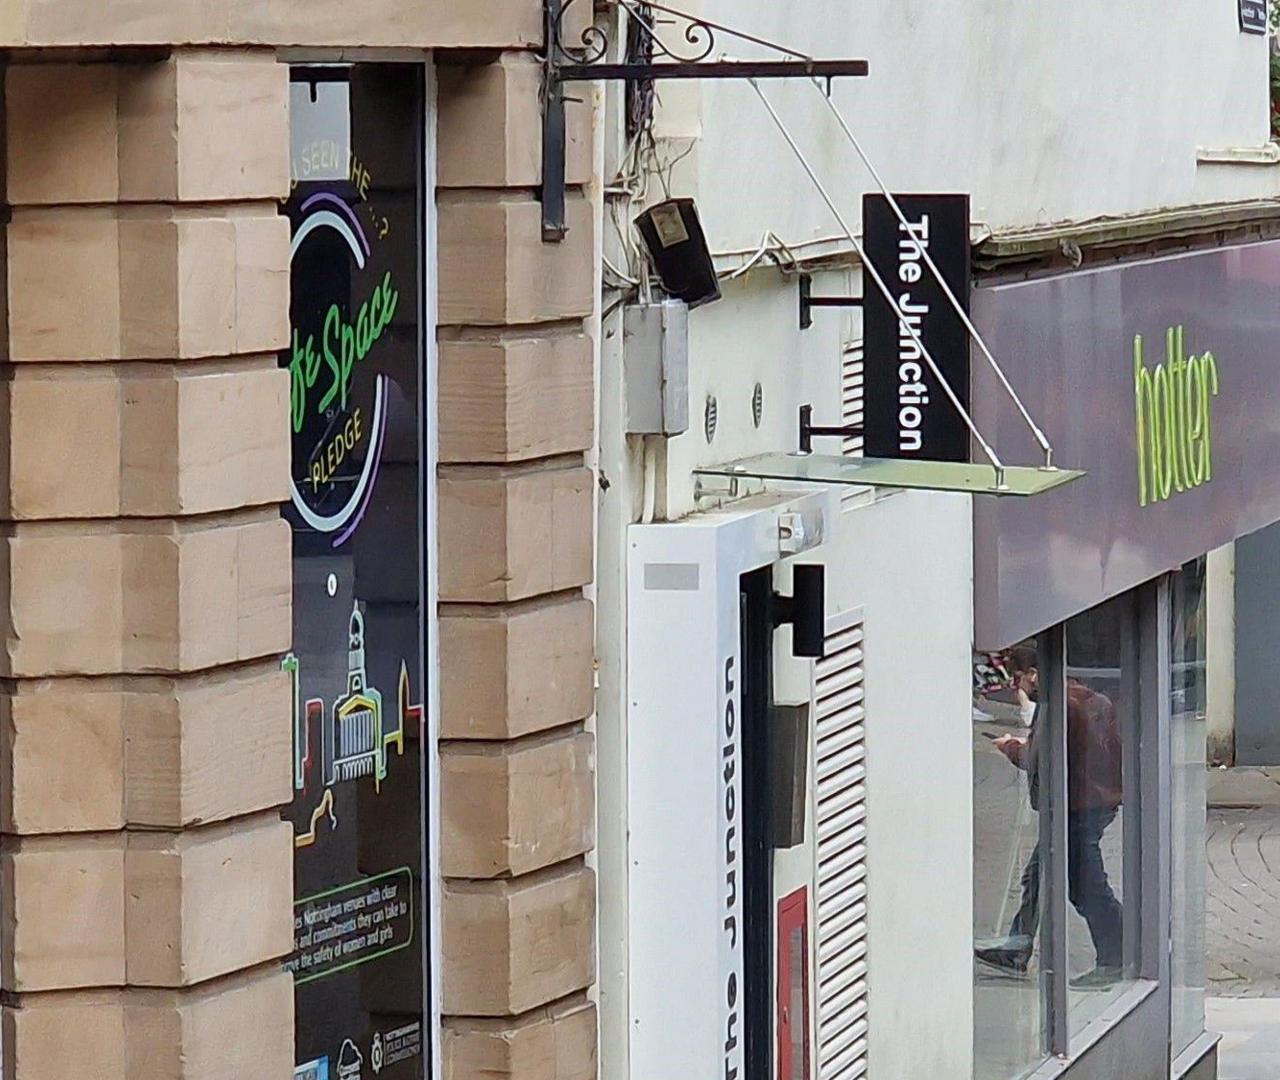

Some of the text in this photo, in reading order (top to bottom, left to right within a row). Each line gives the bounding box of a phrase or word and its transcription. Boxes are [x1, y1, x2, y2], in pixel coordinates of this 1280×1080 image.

[318, 271, 398, 414] Space
[899, 215, 929, 450] The Junction
[1134, 325, 1218, 507] hotter
[311, 408, 362, 494] PLEDGE
[722, 655, 737, 950] Junction
